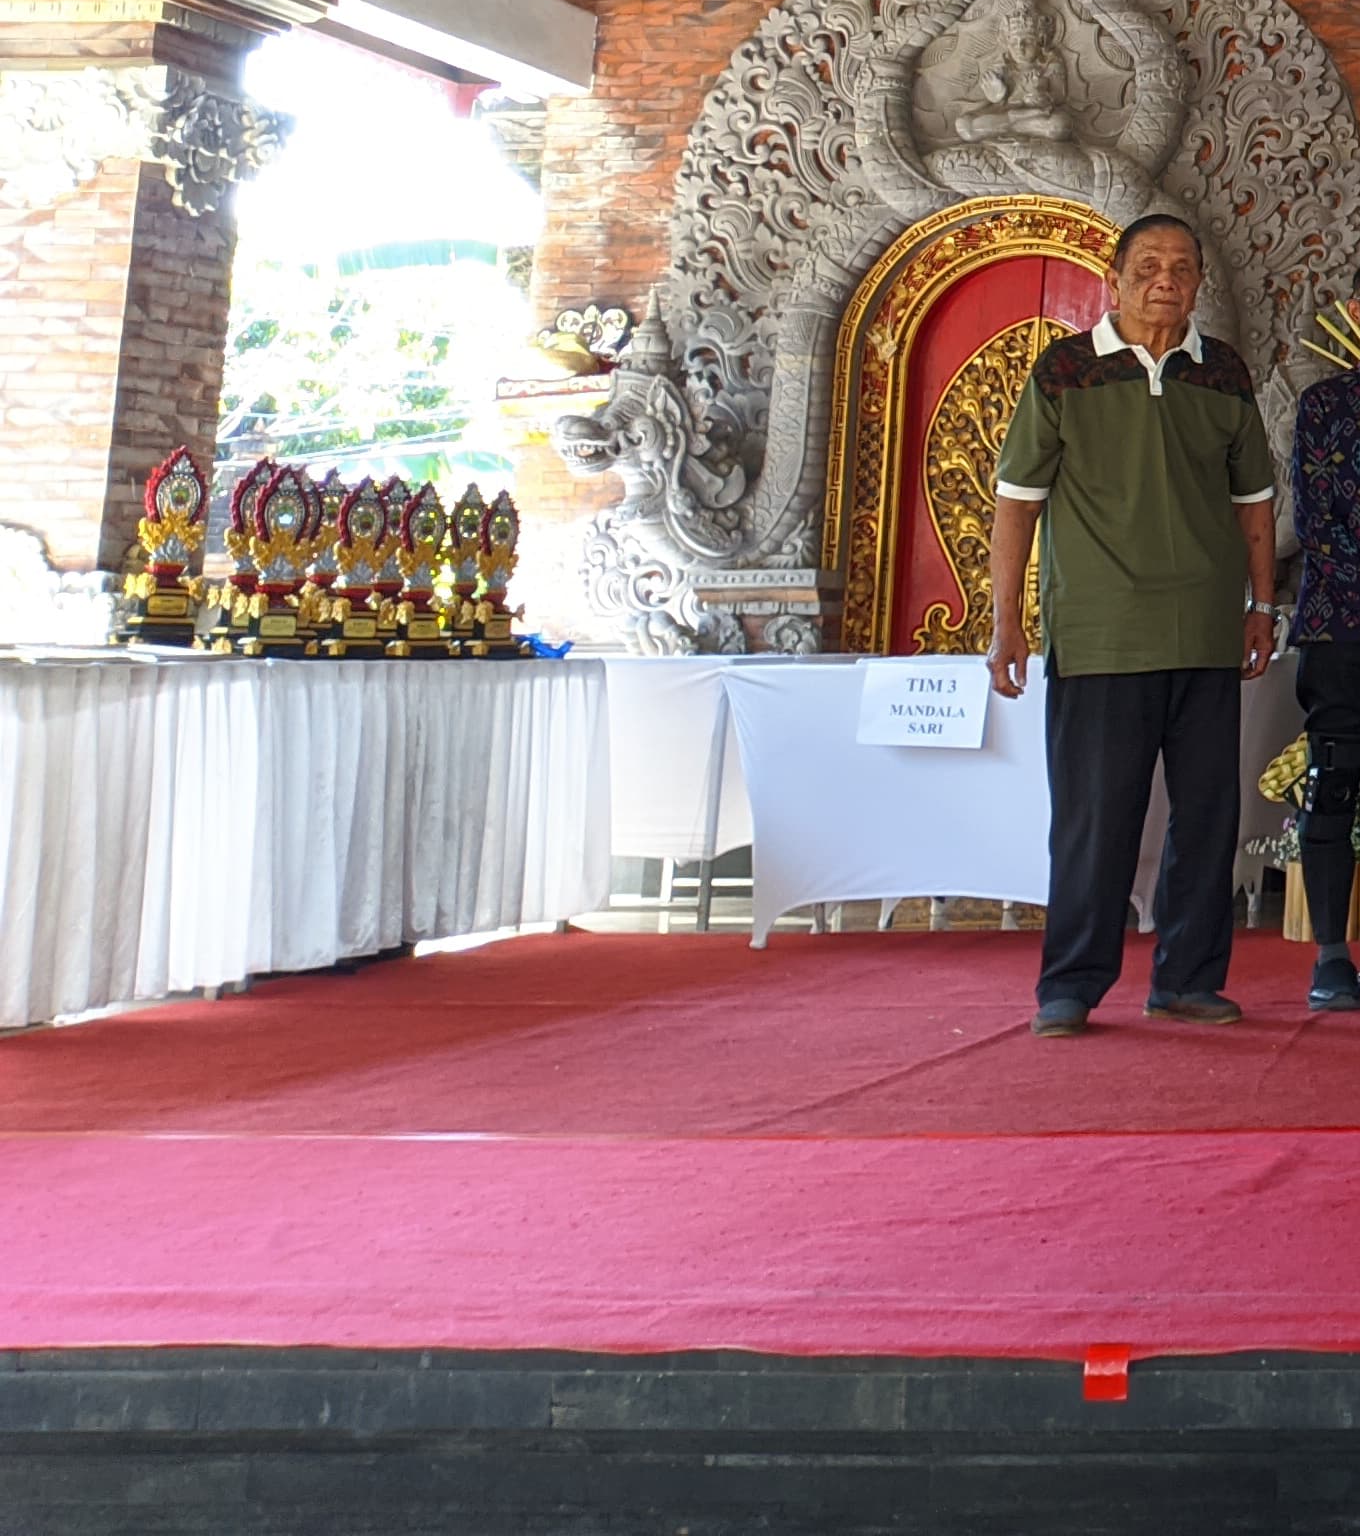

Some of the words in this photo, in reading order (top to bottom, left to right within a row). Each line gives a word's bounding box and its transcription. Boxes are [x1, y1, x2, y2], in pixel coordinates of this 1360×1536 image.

[906, 677, 943, 693] TIM
[947, 679, 957, 693] 3
[889, 704, 966, 719] MANDALA
[907, 722, 943, 735] SARI
